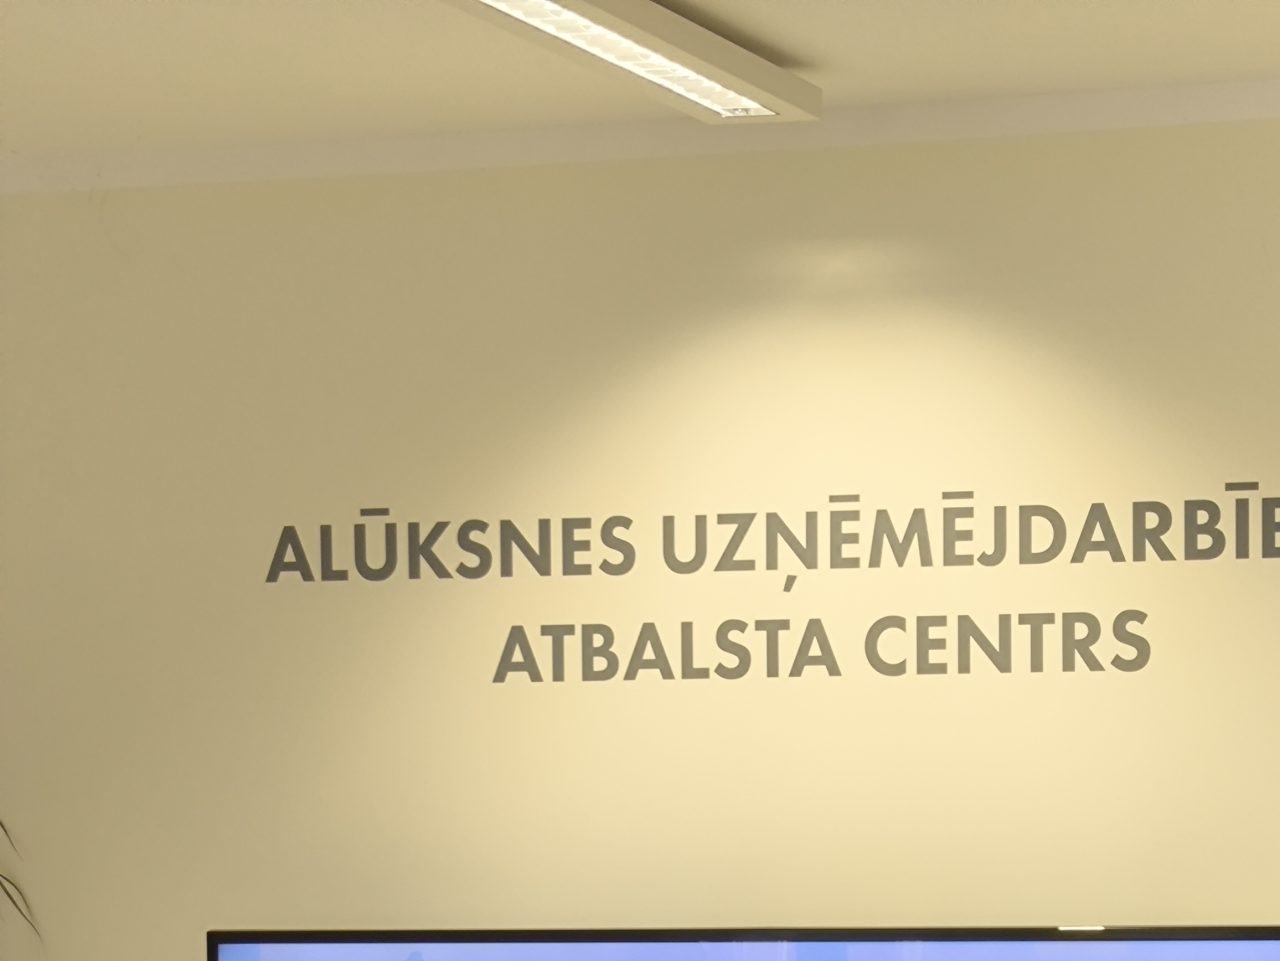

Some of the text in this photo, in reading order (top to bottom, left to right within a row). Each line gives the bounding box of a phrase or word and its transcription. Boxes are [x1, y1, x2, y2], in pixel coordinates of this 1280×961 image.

[264, 507, 635, 584] ALŪKSNES
[492, 610, 1151, 683] ATBALSTA CENTRS
